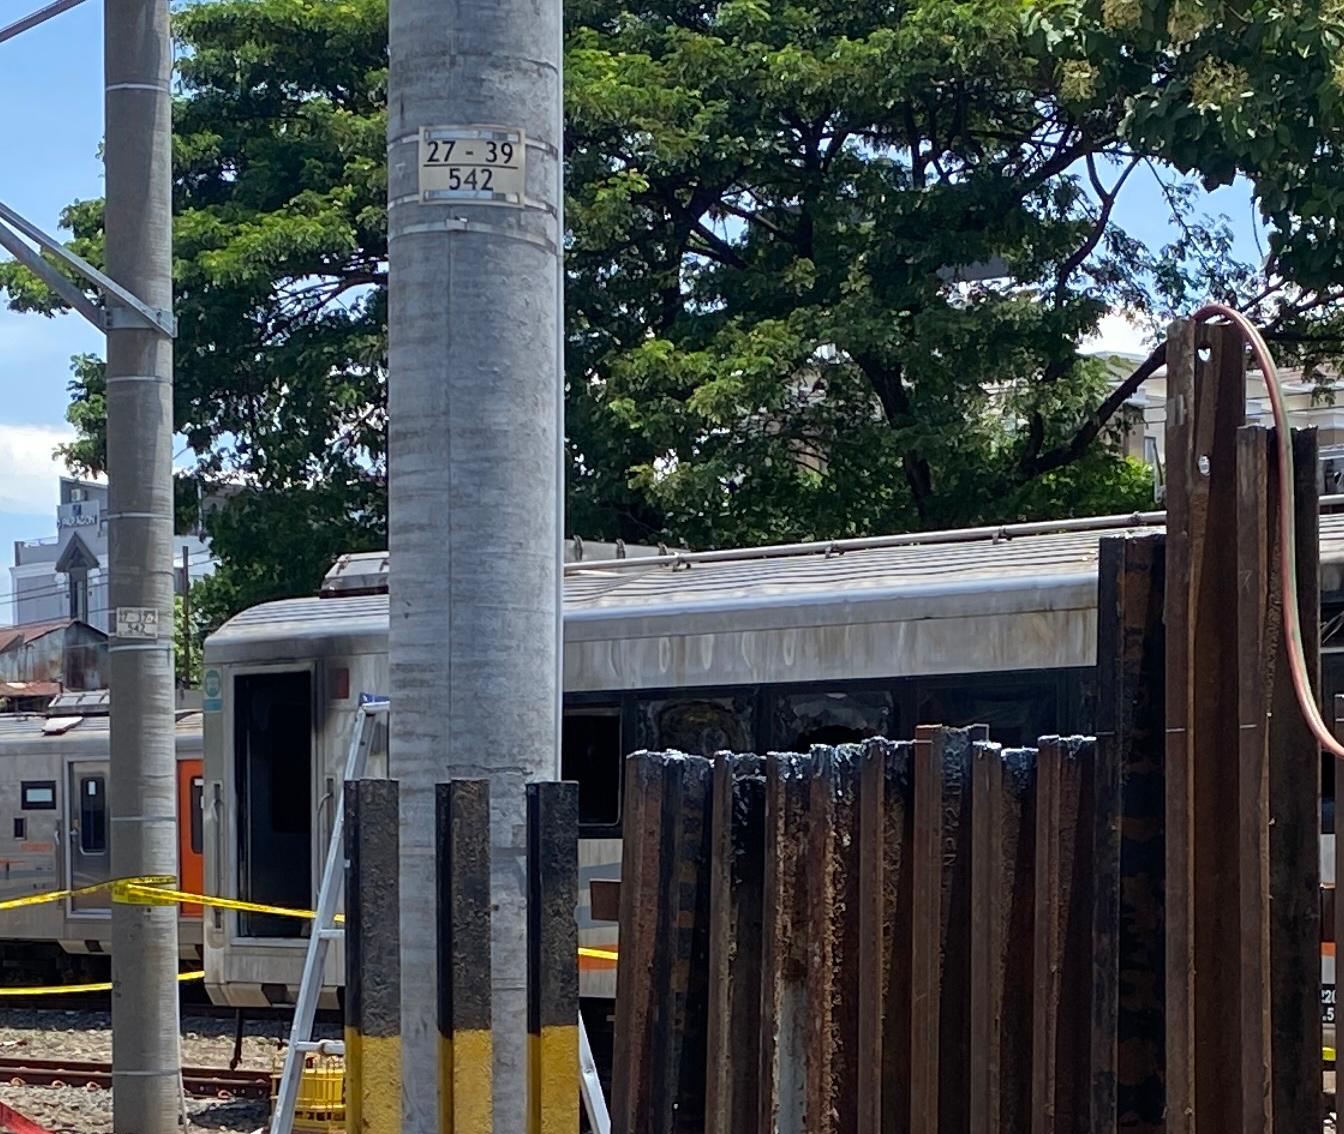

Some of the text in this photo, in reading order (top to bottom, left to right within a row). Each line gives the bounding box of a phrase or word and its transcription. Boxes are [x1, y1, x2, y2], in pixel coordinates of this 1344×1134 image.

[426, 141, 456, 163] 27
[485, 142, 514, 164] 39
[449, 168, 494, 191] 542
